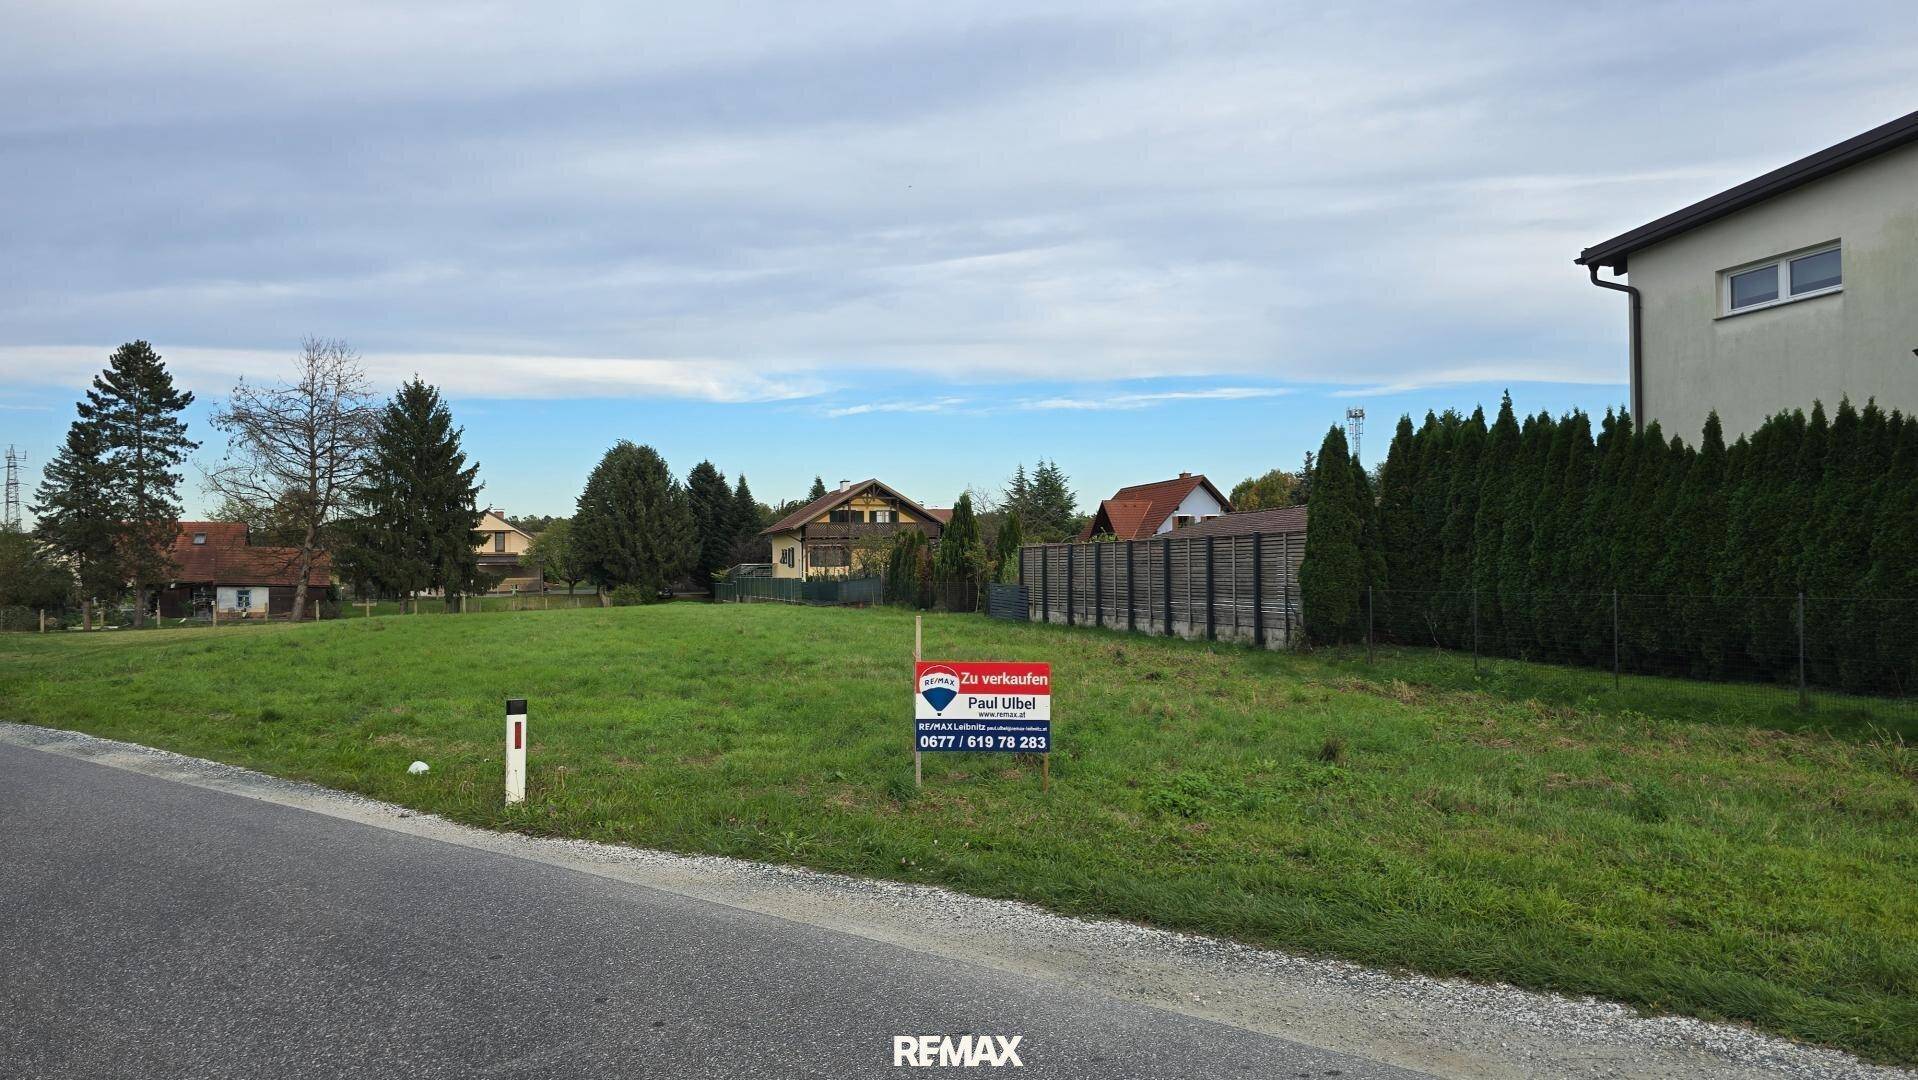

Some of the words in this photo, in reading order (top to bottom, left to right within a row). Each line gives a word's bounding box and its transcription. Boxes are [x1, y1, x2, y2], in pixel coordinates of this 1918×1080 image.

[924, 677, 955, 687] RE/MAX
[961, 672, 978, 684] Zu
[982, 672, 1048, 685] verkaufen
[968, 697, 997, 709] Paul
[1002, 697, 1036, 709] Ulbel
[919, 723, 953, 731] RE/MAX
[953, 723, 986, 731] Leibnitz
[920, 735, 955, 748] 0677
[967, 736, 994, 748] 619
[998, 736, 1015, 748] 78
[1020, 736, 1046, 749] 283
